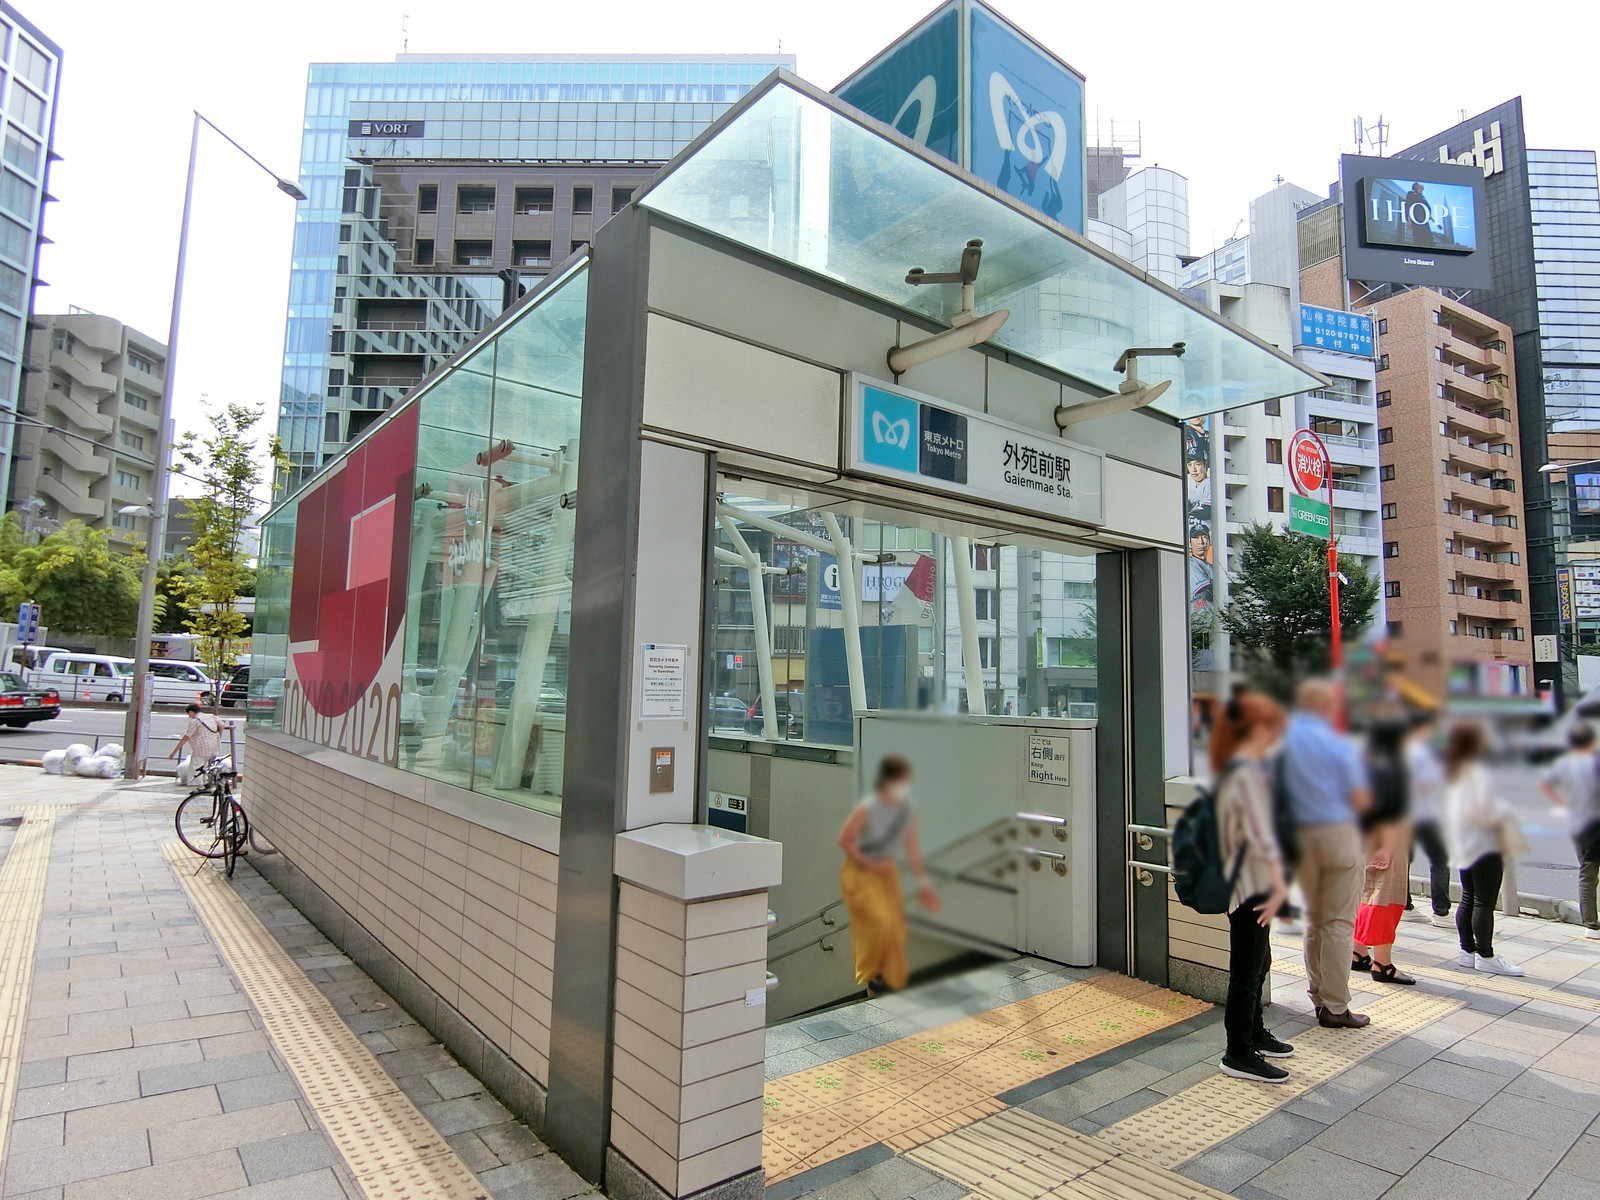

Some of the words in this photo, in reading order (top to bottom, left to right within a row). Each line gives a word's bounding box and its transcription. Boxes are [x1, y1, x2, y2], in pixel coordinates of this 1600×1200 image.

[375, 123, 409, 134] VORT
[1371, 198, 1380, 221] I
[1386, 200, 1470, 229] HOPE
[1404, 257, 1417, 265] Live
[1416, 259, 1435, 267] Board
[1315, 336, 1360, 352] 受付中
[924, 430, 964, 451] 東京メトロ
[926, 443, 944, 455] Tokyo
[944, 448, 962, 460] Metro
[1003, 440, 1071, 484] 外苑前駅
[1297, 452, 1322, 478] 消火栓
[1004, 470, 1055, 495] Gaiemmae
[1056, 484, 1074, 499] Sta.
[1298, 509, 1316, 523] GREEN
[1315, 514, 1329, 526] SEED
[282, 678, 334, 748] TOKYO
[337, 681, 401, 769] 2020
[1031, 737, 1052, 746] ここでは
[1031, 761, 1044, 769] Keep
[1031, 769, 1054, 781] Right
[1054, 775, 1068, 783] Here
